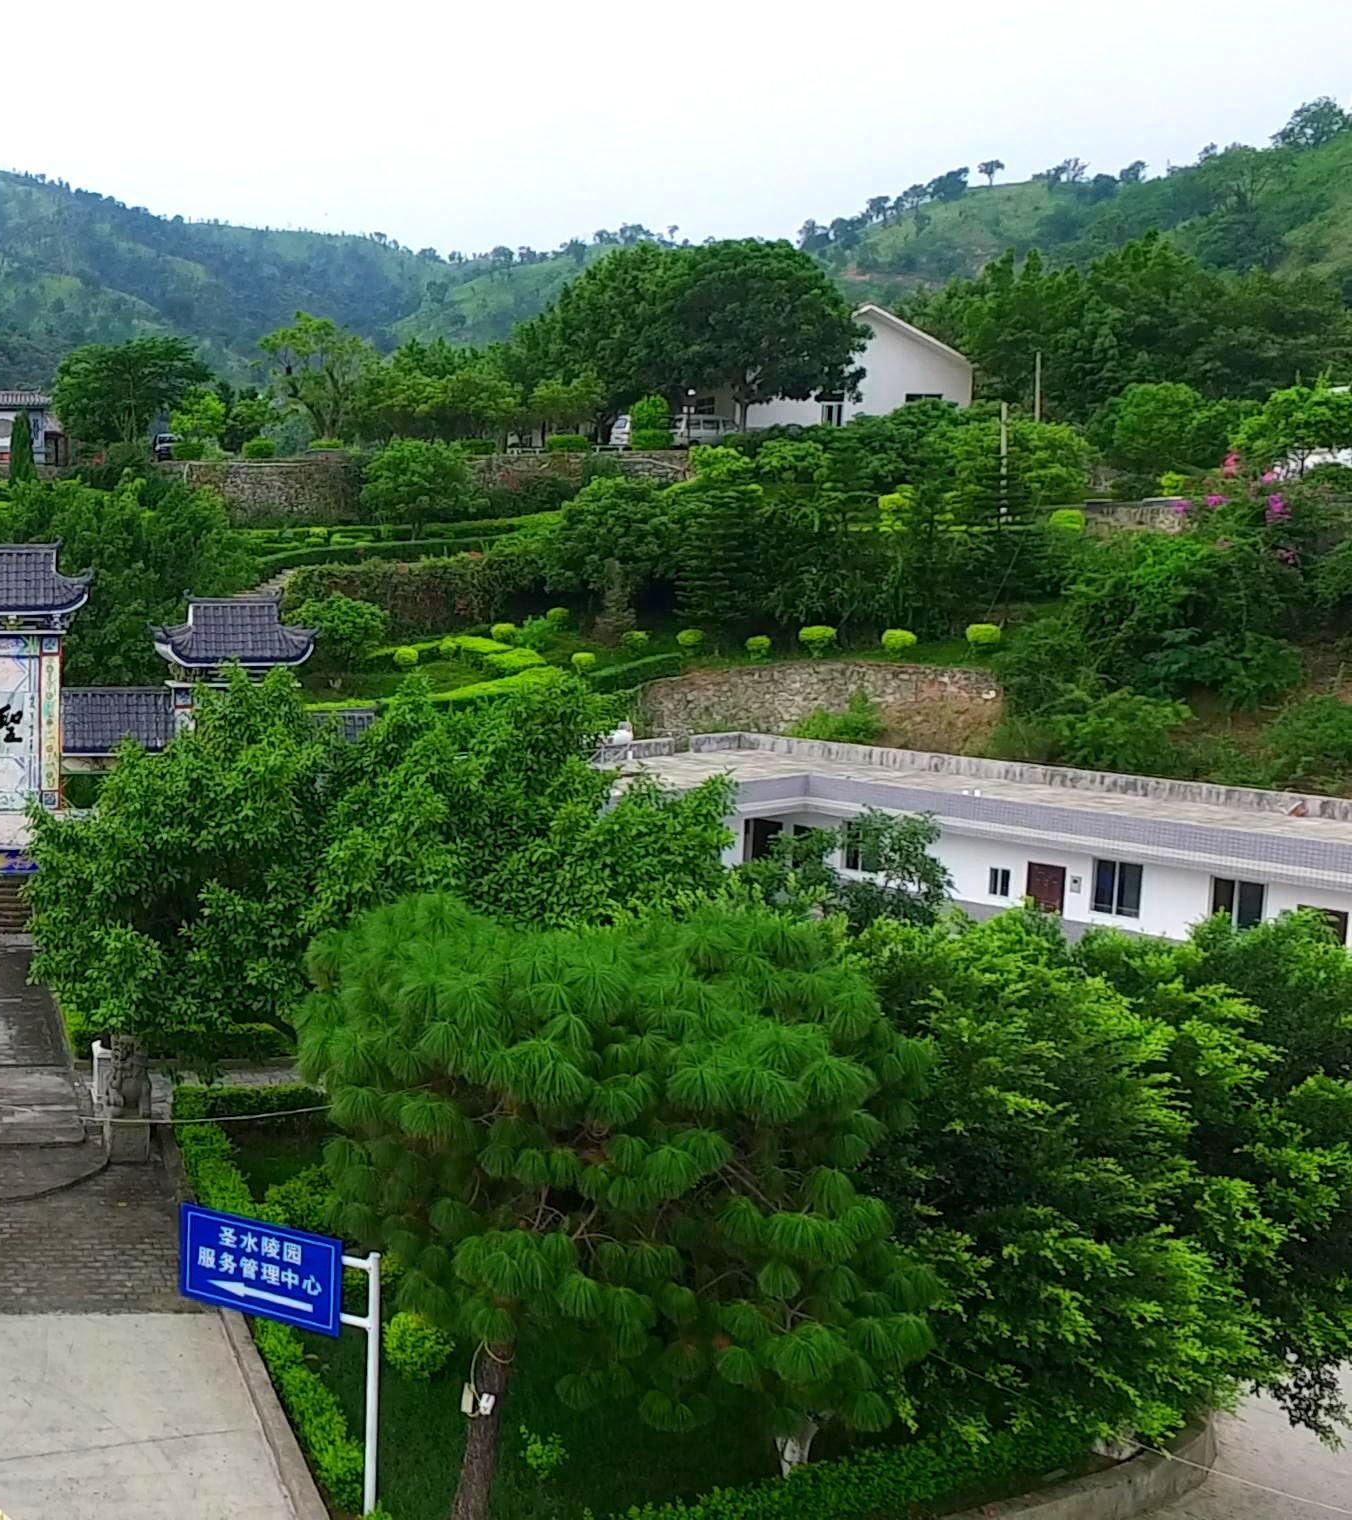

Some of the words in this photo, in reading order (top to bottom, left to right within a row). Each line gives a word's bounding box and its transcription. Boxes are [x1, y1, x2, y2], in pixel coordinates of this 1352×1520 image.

[218, 1225, 302, 1266] 圣水陵园
[197, 1246, 323, 1296] 服务管理中心
